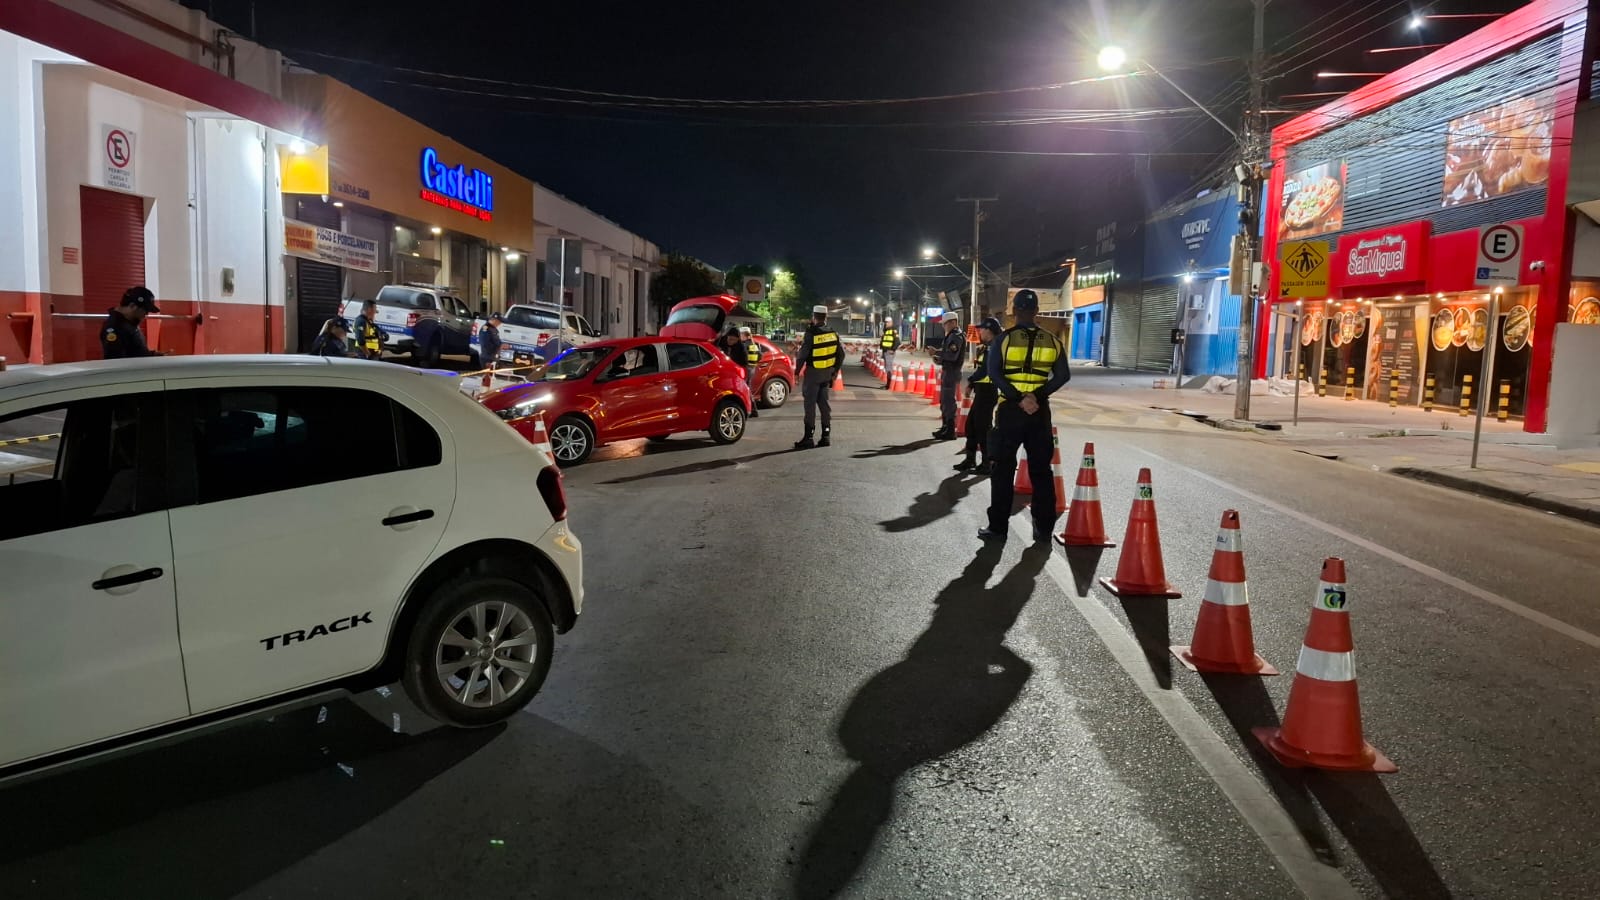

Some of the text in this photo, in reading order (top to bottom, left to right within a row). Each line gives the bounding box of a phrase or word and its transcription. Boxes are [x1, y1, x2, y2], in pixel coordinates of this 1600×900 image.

[421, 147, 492, 211] Castelli
[1493, 234, 1507, 253] E
[260, 611, 373, 650] TRACK
